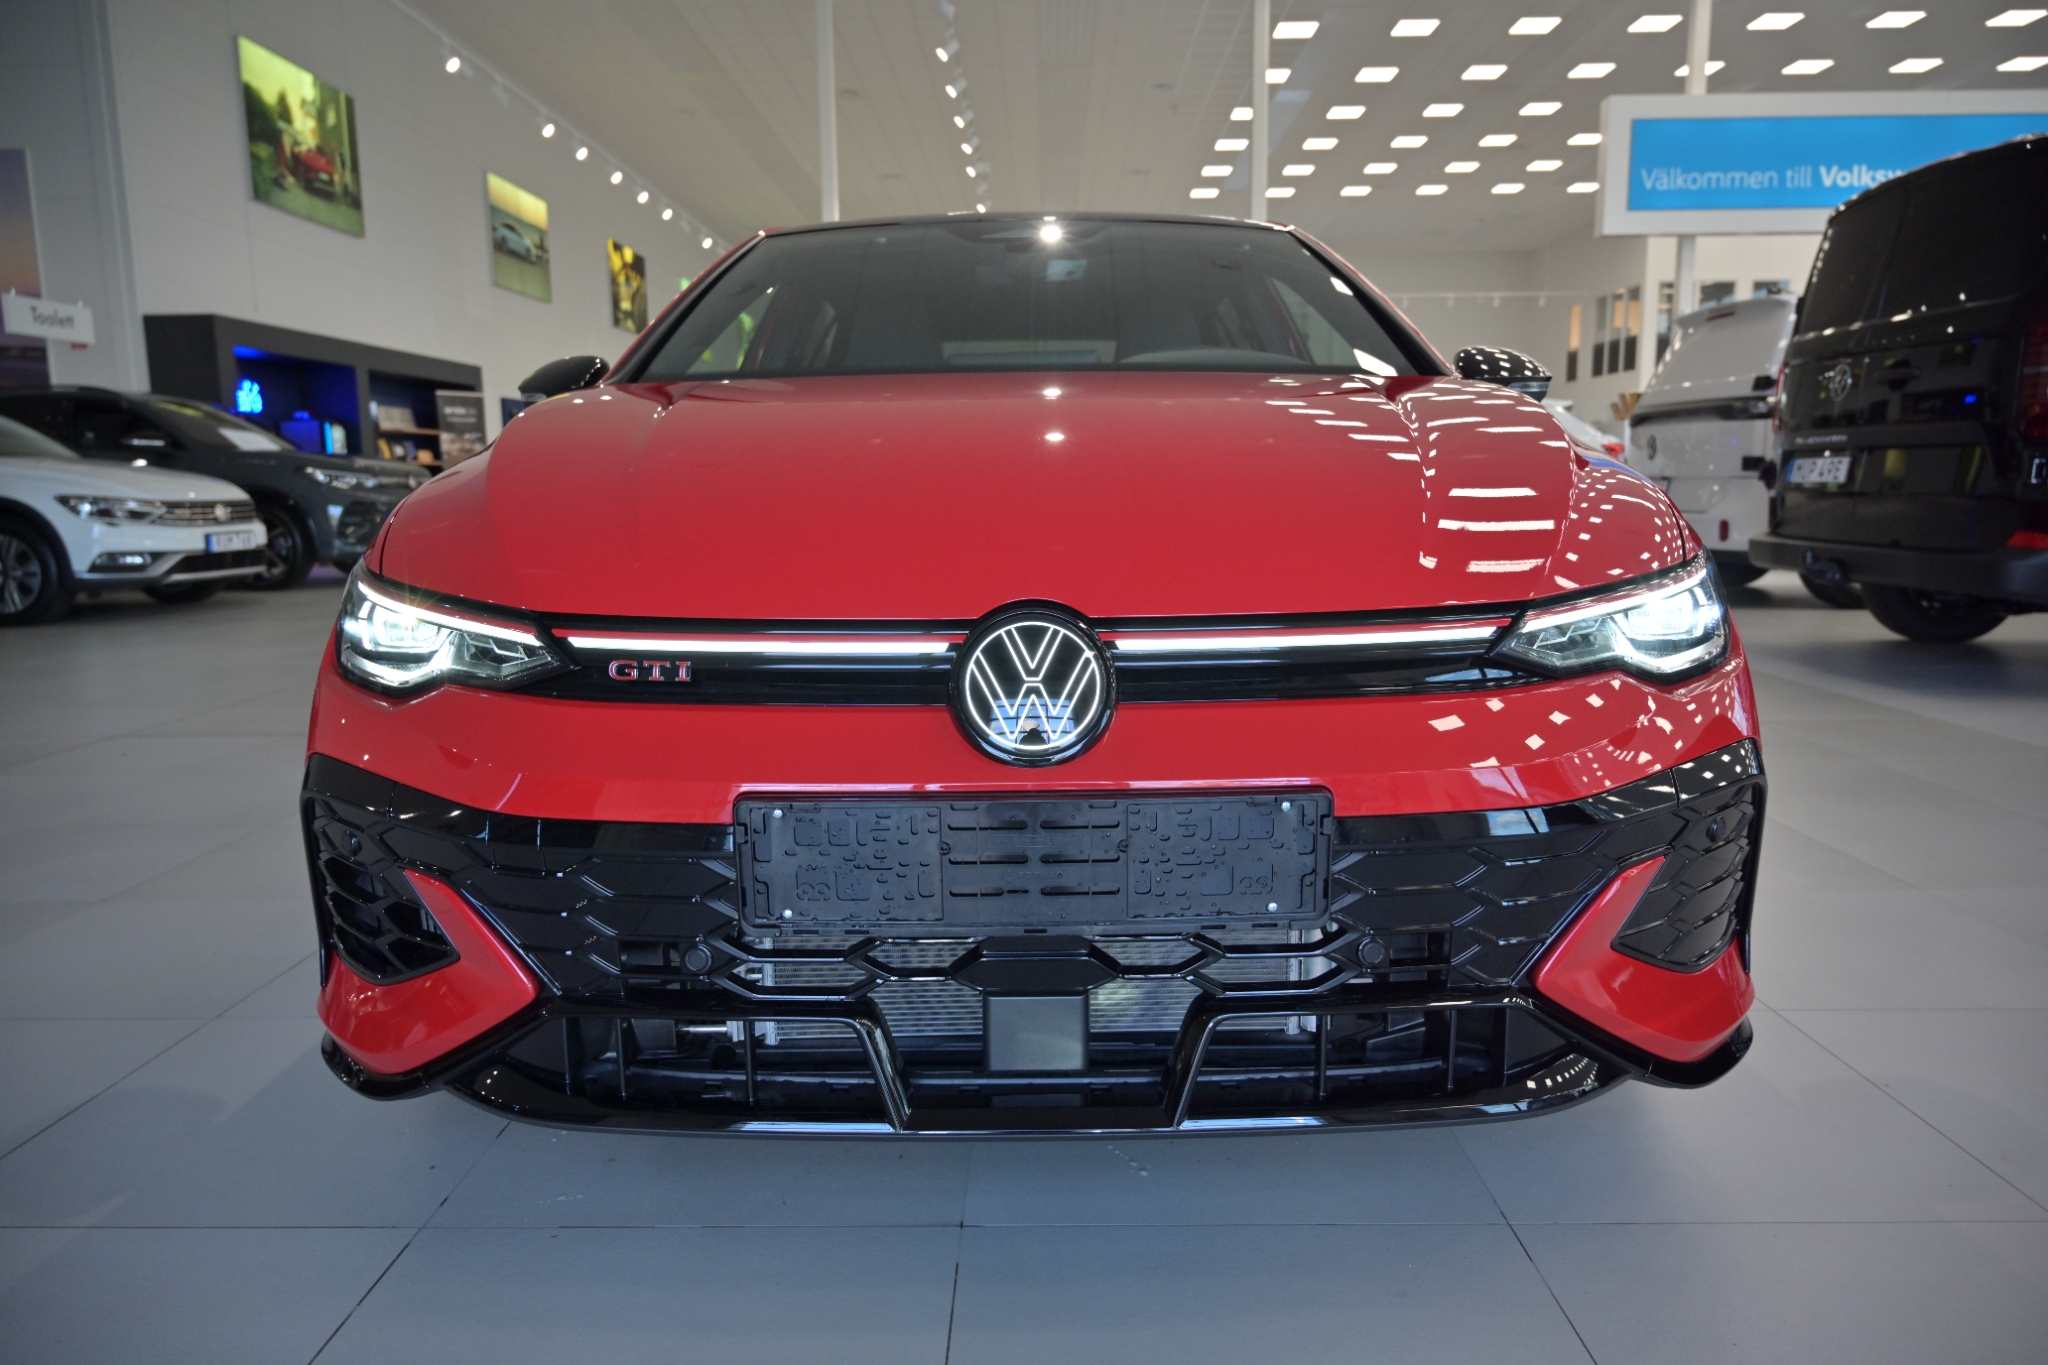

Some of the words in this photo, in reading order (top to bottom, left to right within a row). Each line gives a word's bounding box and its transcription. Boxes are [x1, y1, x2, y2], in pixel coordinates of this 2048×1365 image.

[1641, 167, 1779, 190] Välkommen
[1786, 165, 1812, 188] till
[30, 306, 74, 330] Toalett
[608, 659, 691, 682] GTI
